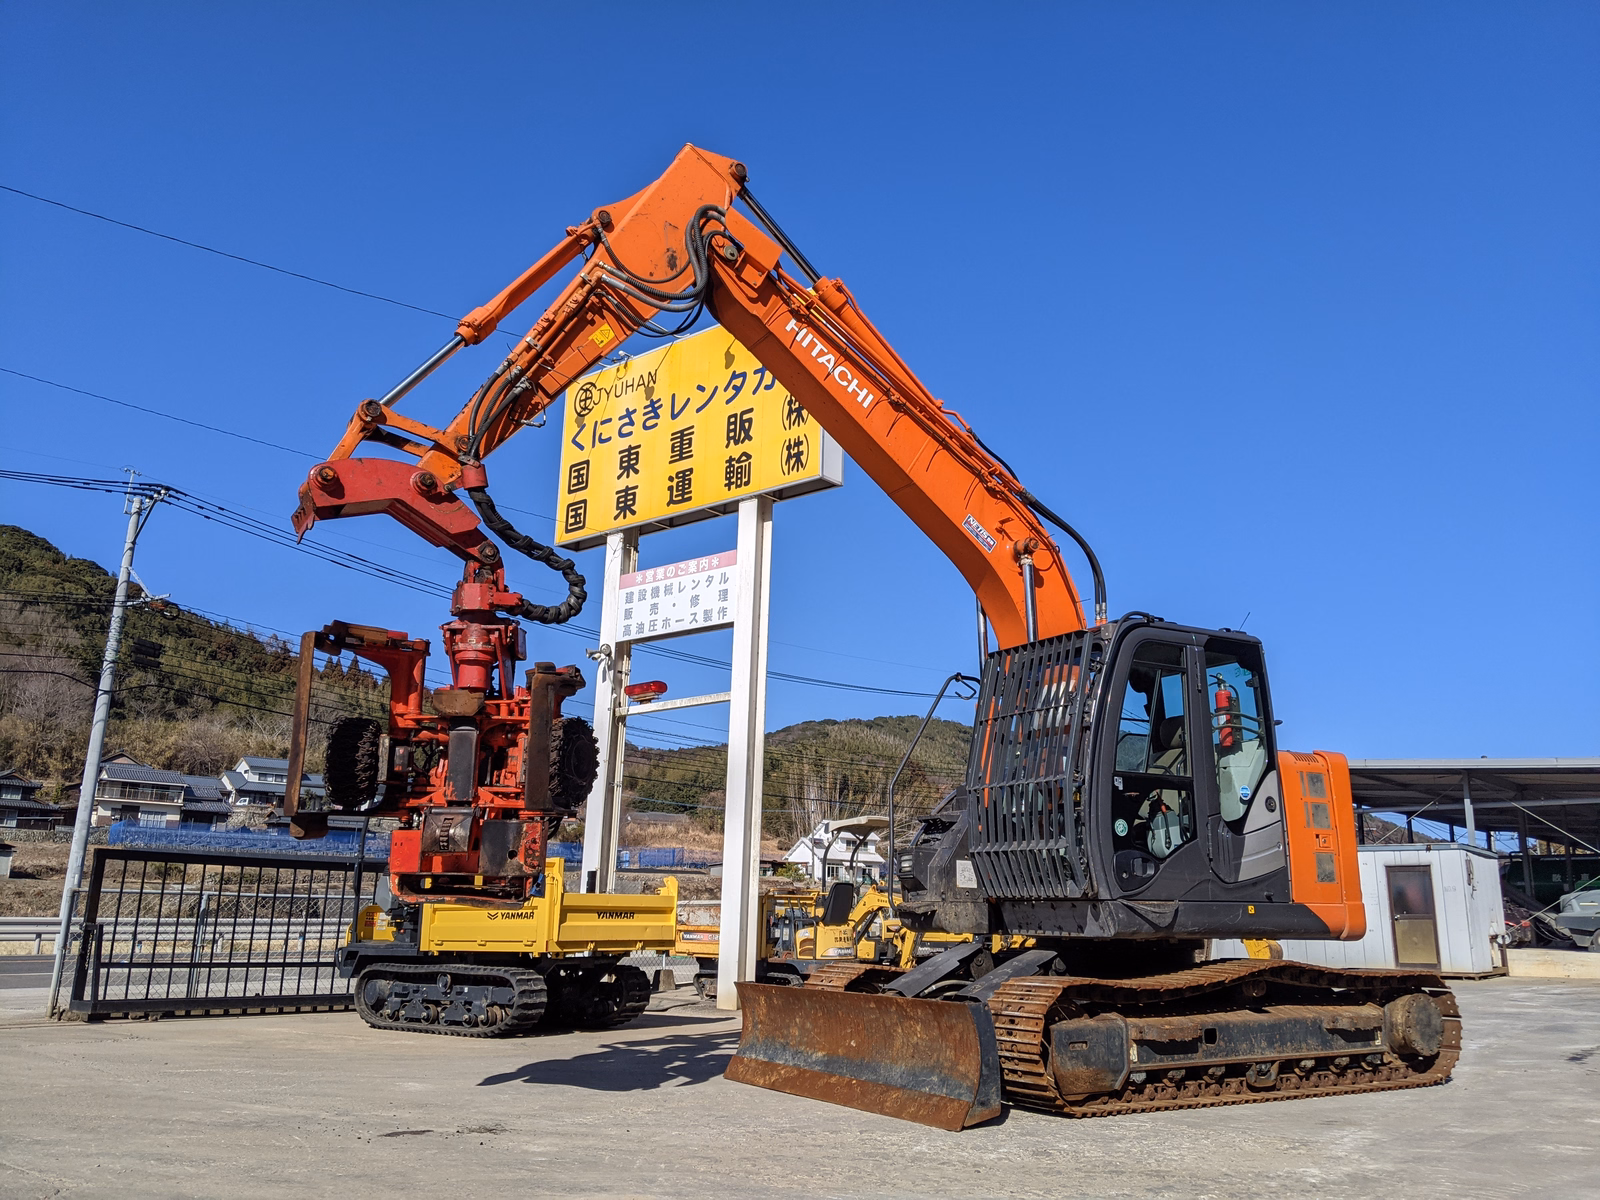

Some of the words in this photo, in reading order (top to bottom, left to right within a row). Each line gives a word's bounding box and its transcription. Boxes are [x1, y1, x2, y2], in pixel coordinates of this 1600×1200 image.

[785, 318, 874, 408] HITACHI
[593, 369, 657, 405] JYUHAN
[565, 433, 809, 534] 国東運輸(株)
[624, 588, 729, 621] 販売・修理
[625, 571, 729, 605] 建設機械レンタル
[622, 606, 728, 637] 高油圧ホース製作
[500, 911, 534, 920] YANMAR
[596, 911, 634, 920] YANMAR
